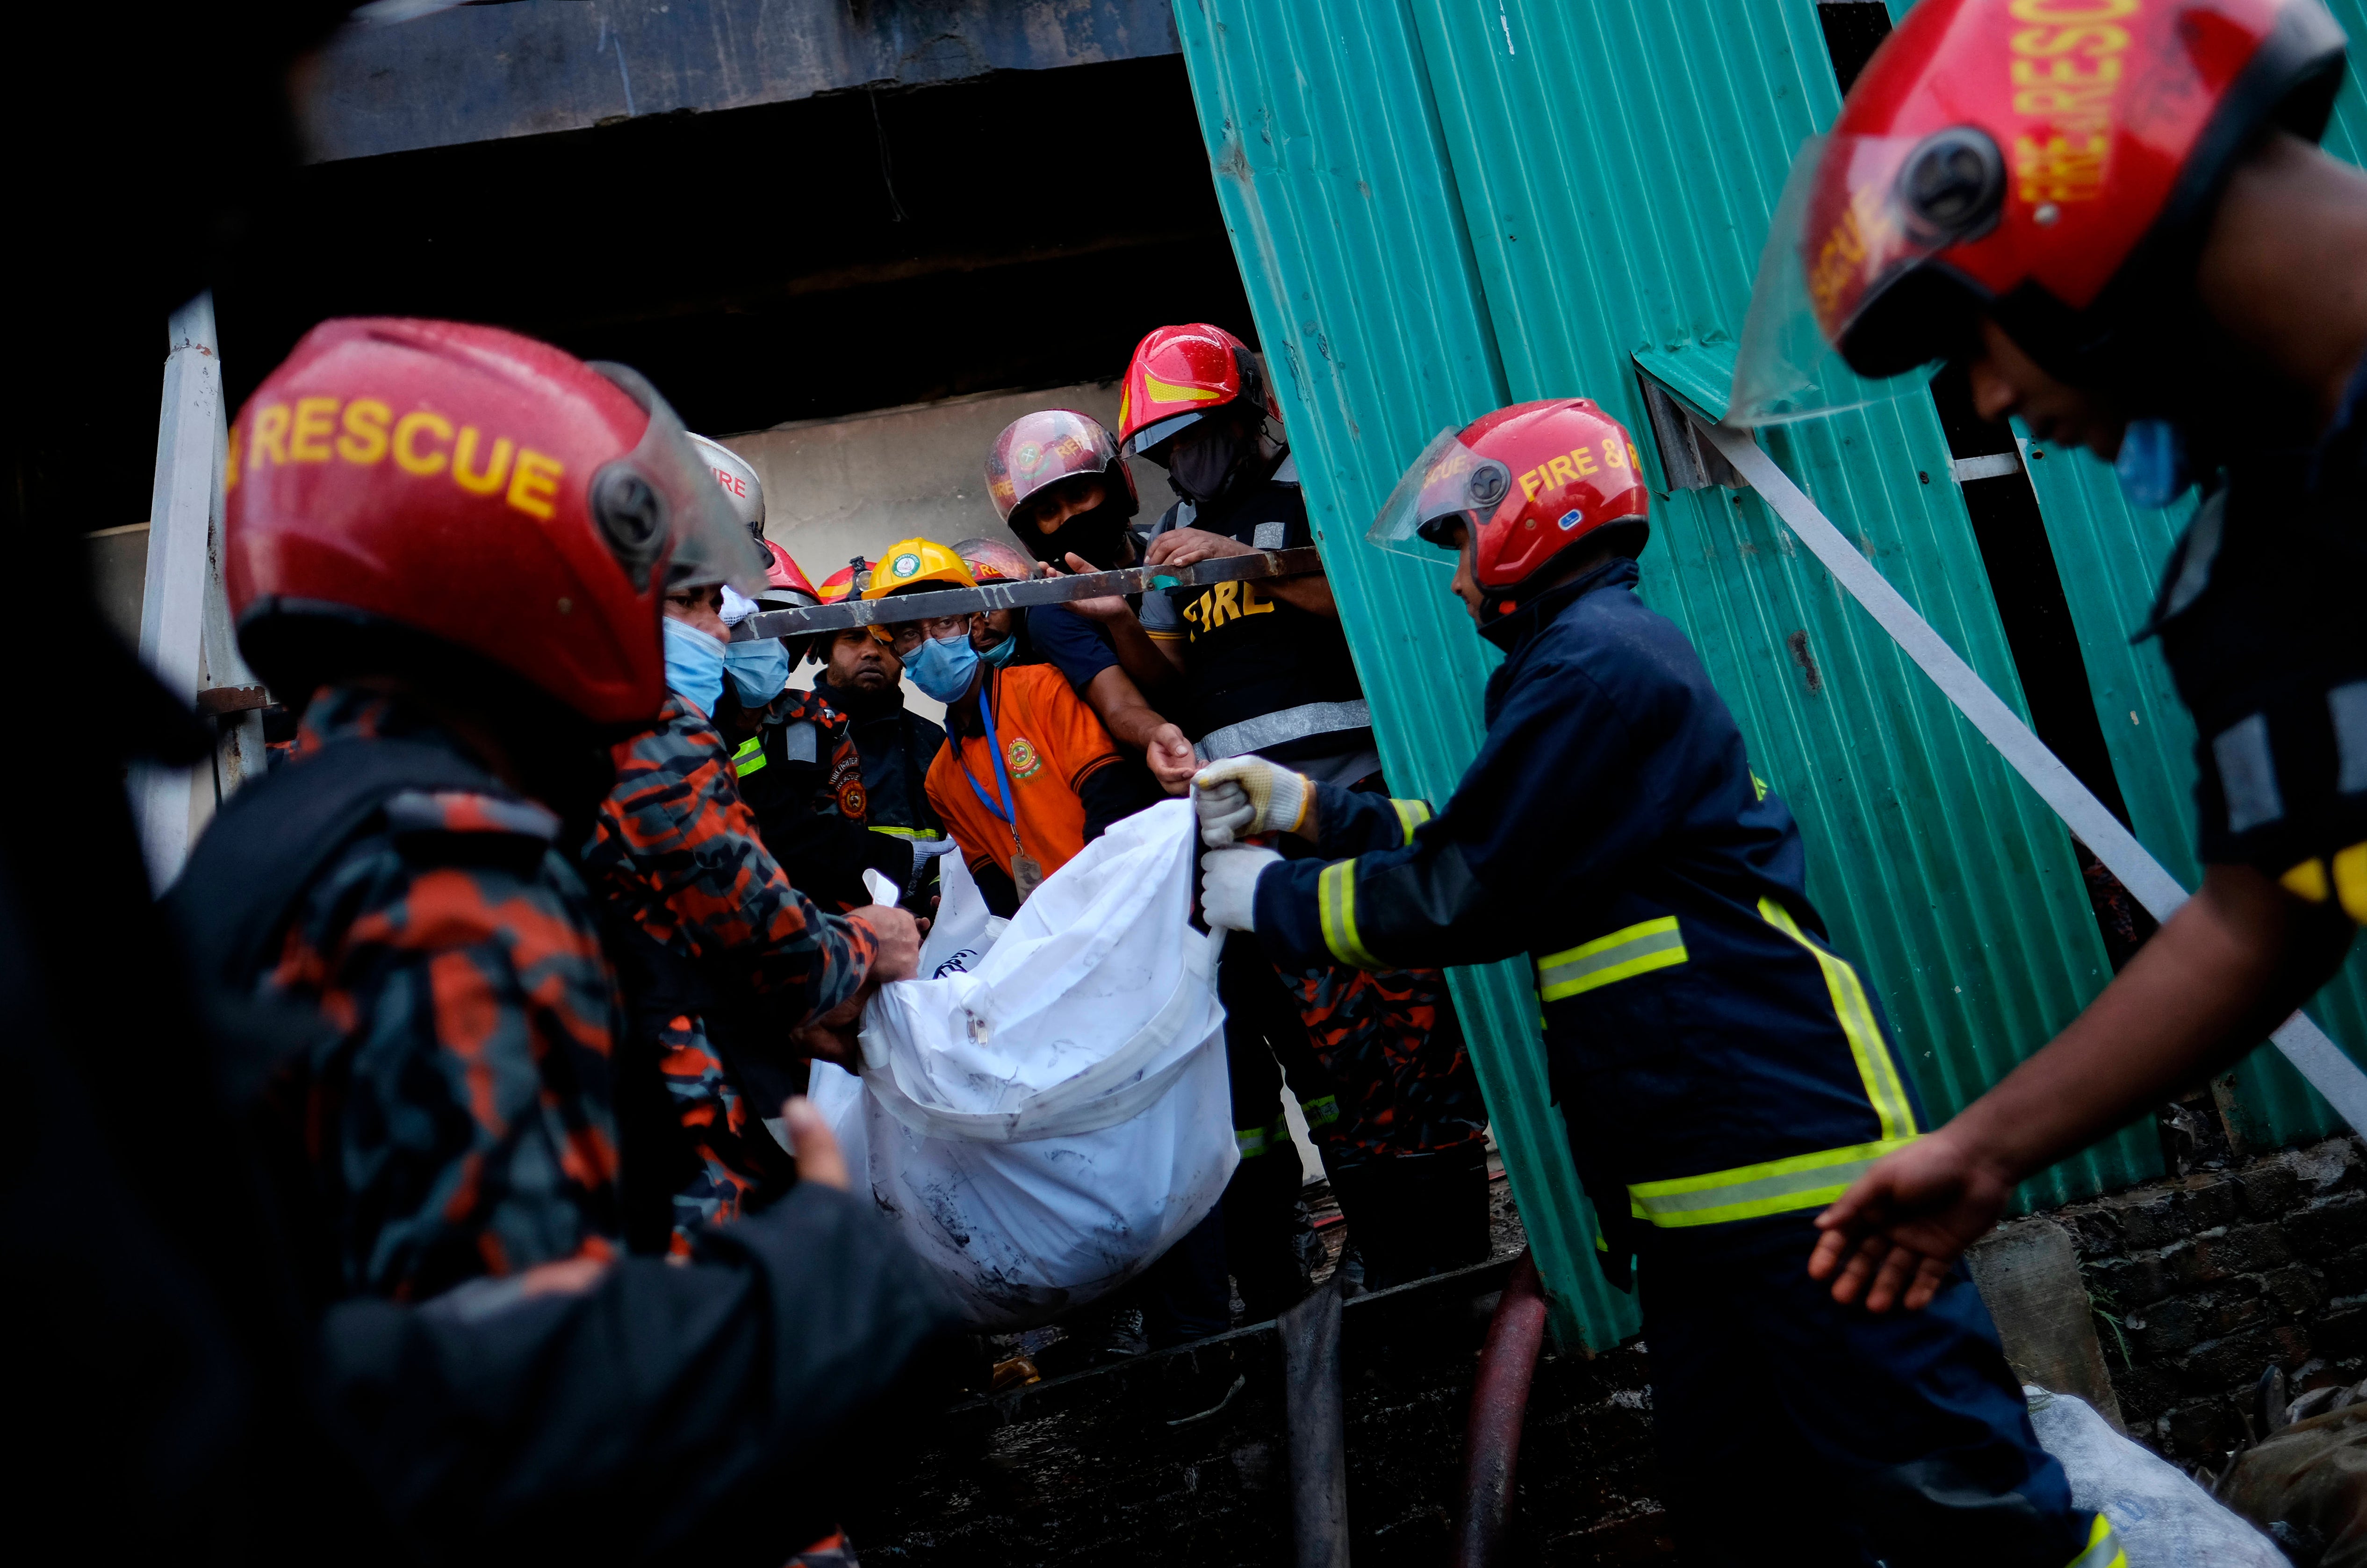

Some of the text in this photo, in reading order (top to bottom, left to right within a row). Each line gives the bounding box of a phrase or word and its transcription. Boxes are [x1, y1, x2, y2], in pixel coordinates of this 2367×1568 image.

[249, 397, 564, 521] RESCUE
[712, 467, 746, 499] IRE
[1518, 446, 1599, 502] FIRE
[1602, 438, 1626, 469] &
[830, 757, 858, 783] FIRE FIGHTER
